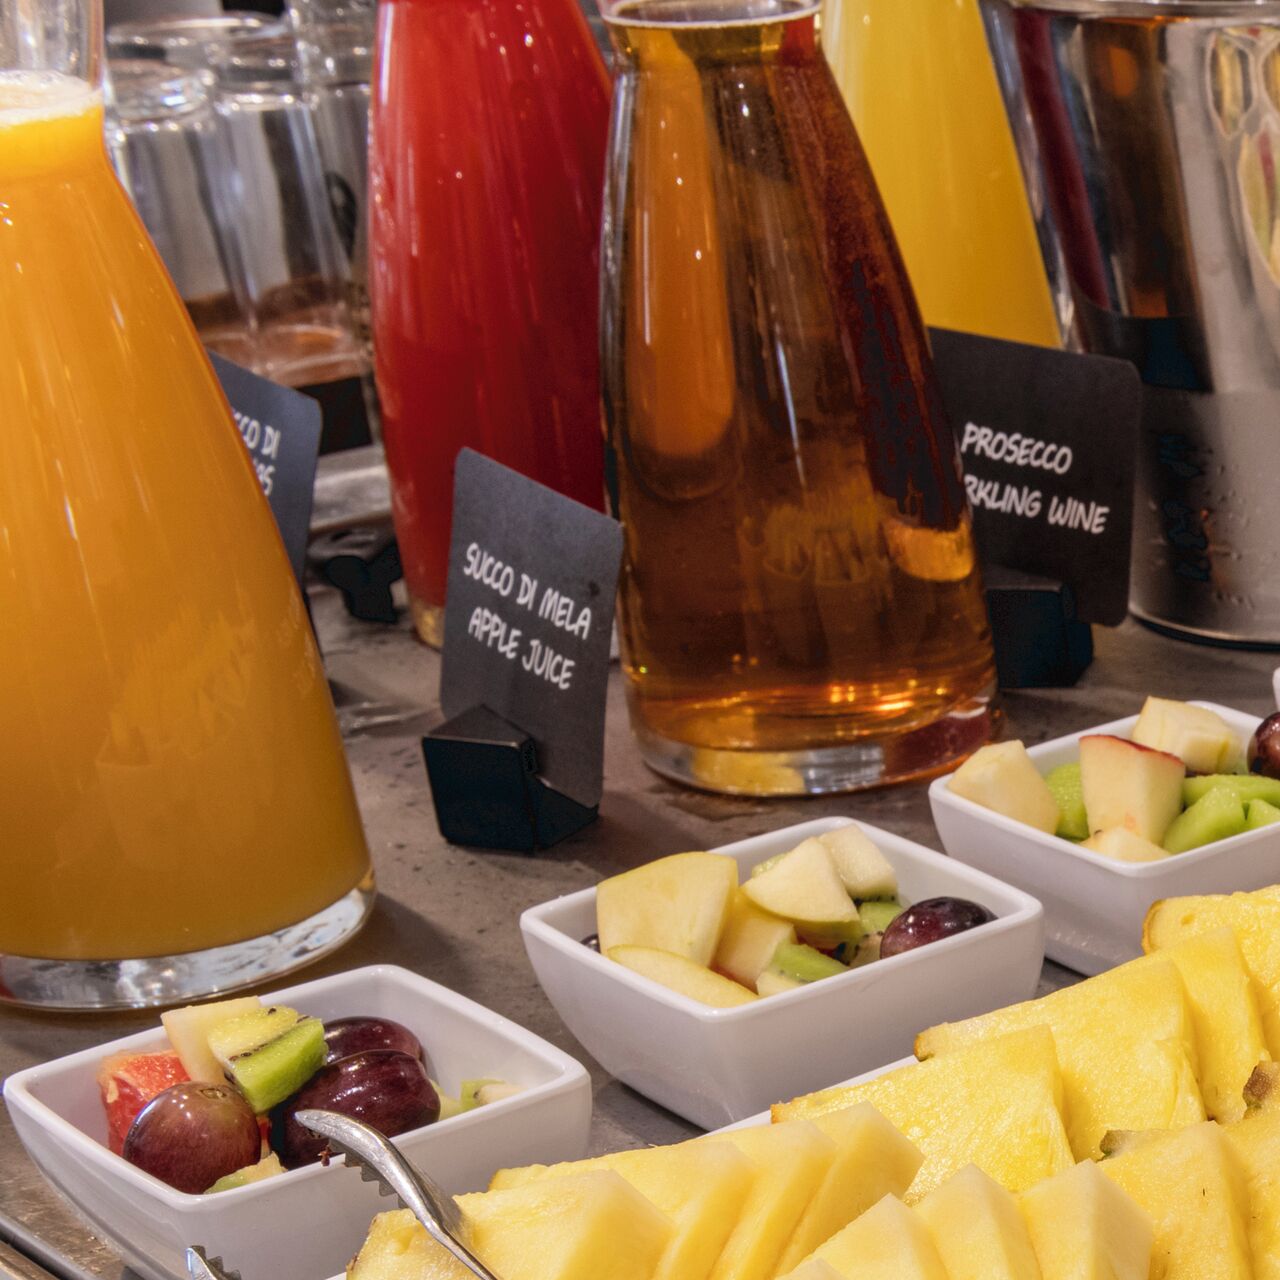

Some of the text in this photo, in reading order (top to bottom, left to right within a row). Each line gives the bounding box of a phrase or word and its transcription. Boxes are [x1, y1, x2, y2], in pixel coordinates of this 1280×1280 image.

[261, 425, 281, 460] DI
[960, 422, 1073, 474] PROSECCO
[964, 473, 1110, 534] RKLING WINE
[463, 542, 592, 640] SUCCO DI MELA
[468, 606, 575, 690] APPLE JUICE
